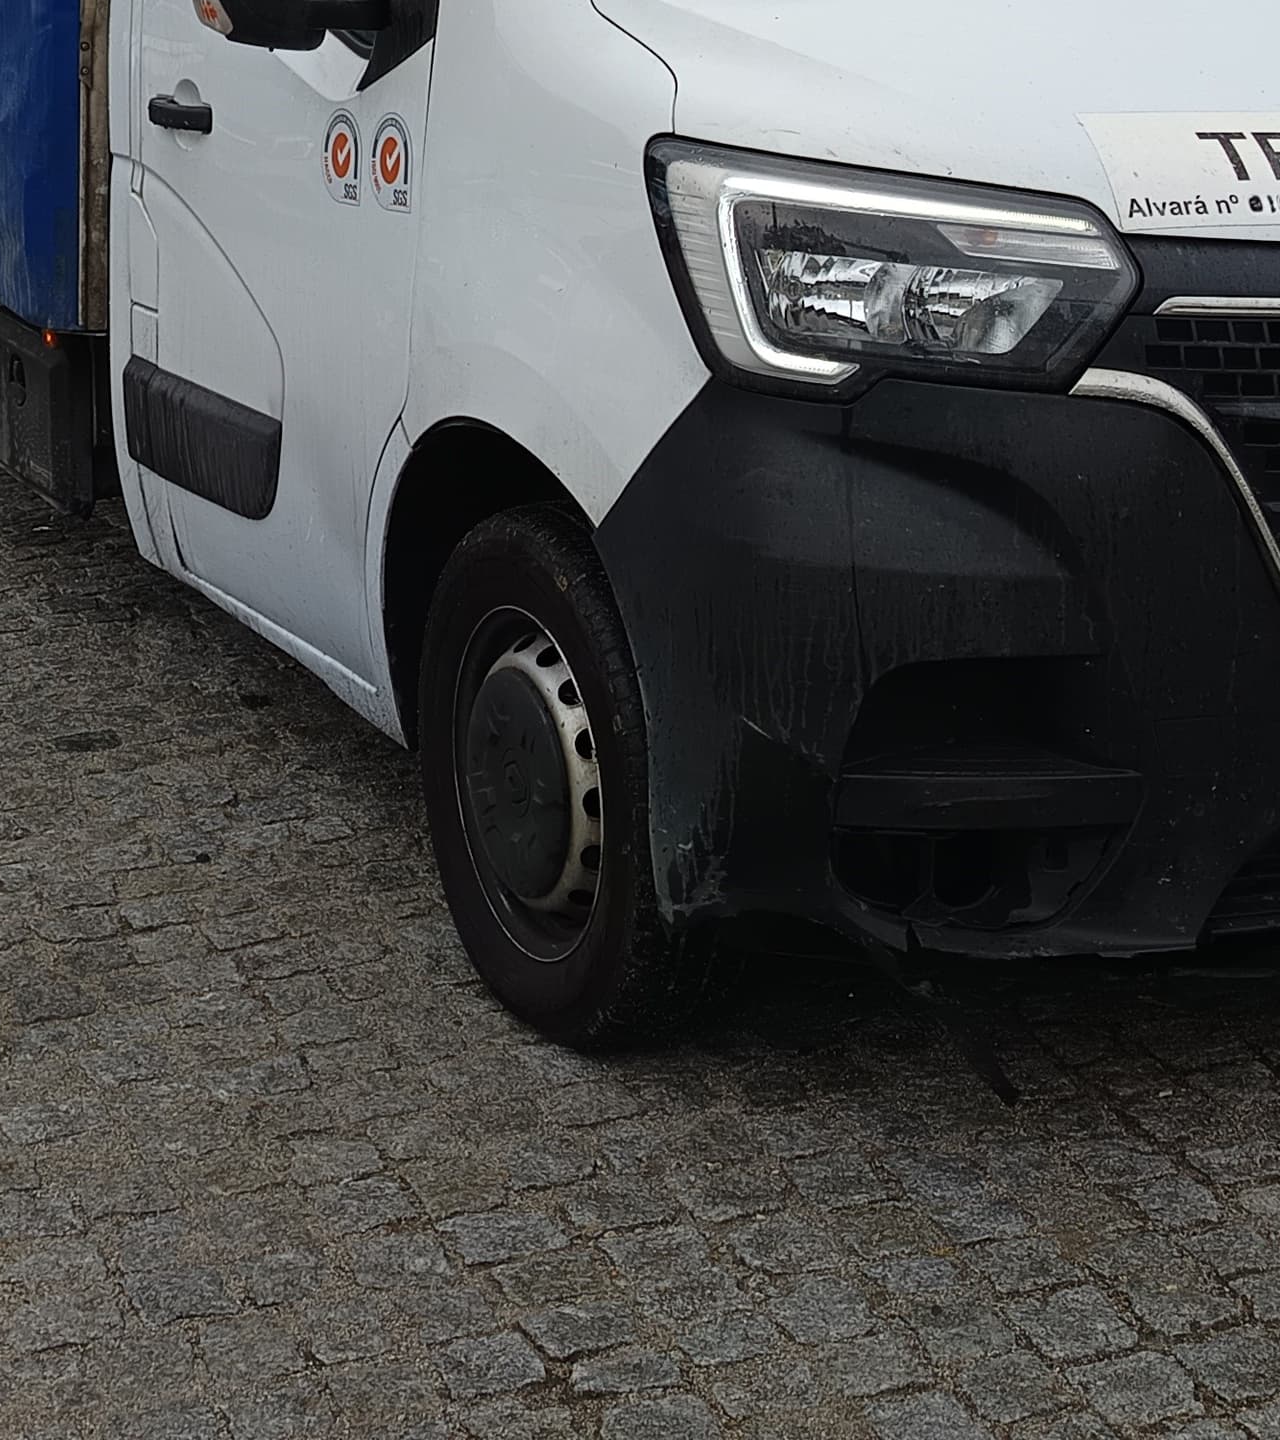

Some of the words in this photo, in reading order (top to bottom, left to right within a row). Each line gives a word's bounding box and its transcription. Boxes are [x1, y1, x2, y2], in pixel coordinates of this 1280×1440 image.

[344, 183, 358, 200] SGS
[393, 189, 408, 206] SGS
[1127, 194, 1209, 218] Alvará
